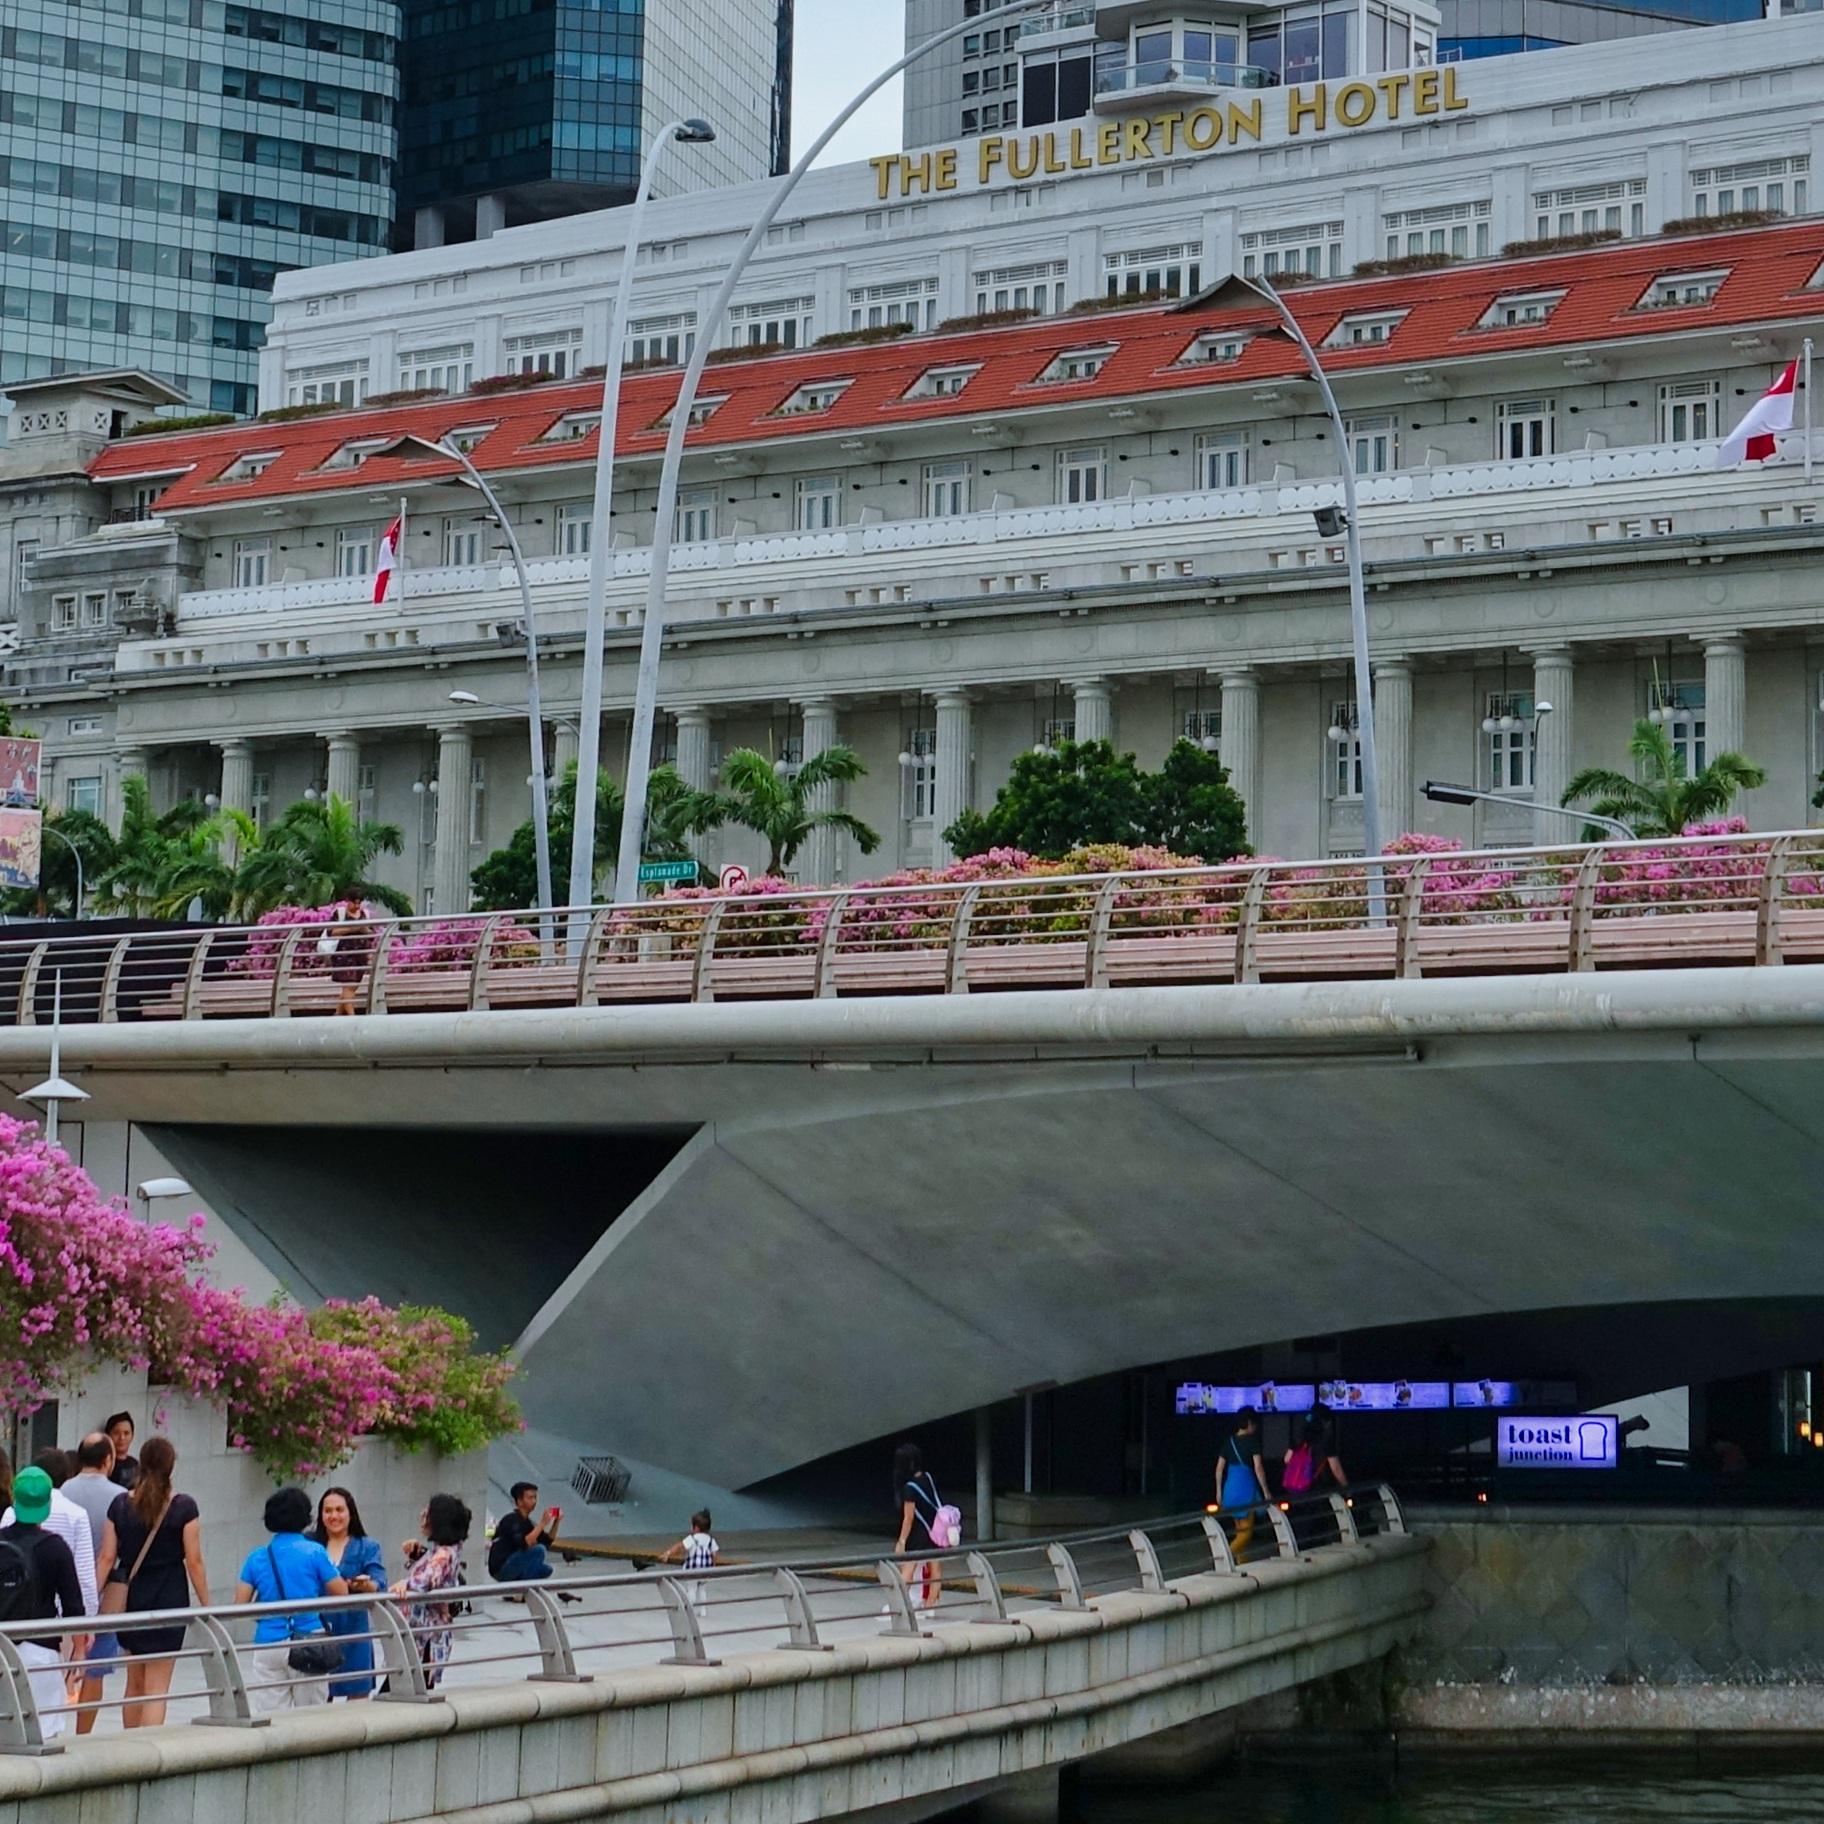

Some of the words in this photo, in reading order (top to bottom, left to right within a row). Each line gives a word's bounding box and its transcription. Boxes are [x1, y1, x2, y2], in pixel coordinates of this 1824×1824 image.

[869, 148, 957, 199] THE
[979, 97, 1261, 184] FULLERTON
[1288, 67, 1469, 135] HOTEL
[640, 865, 681, 880] Esplanade
[683, 863, 693, 875] Dr
[1508, 1424, 1572, 1445] toast
[1507, 1446, 1573, 1464] junction
